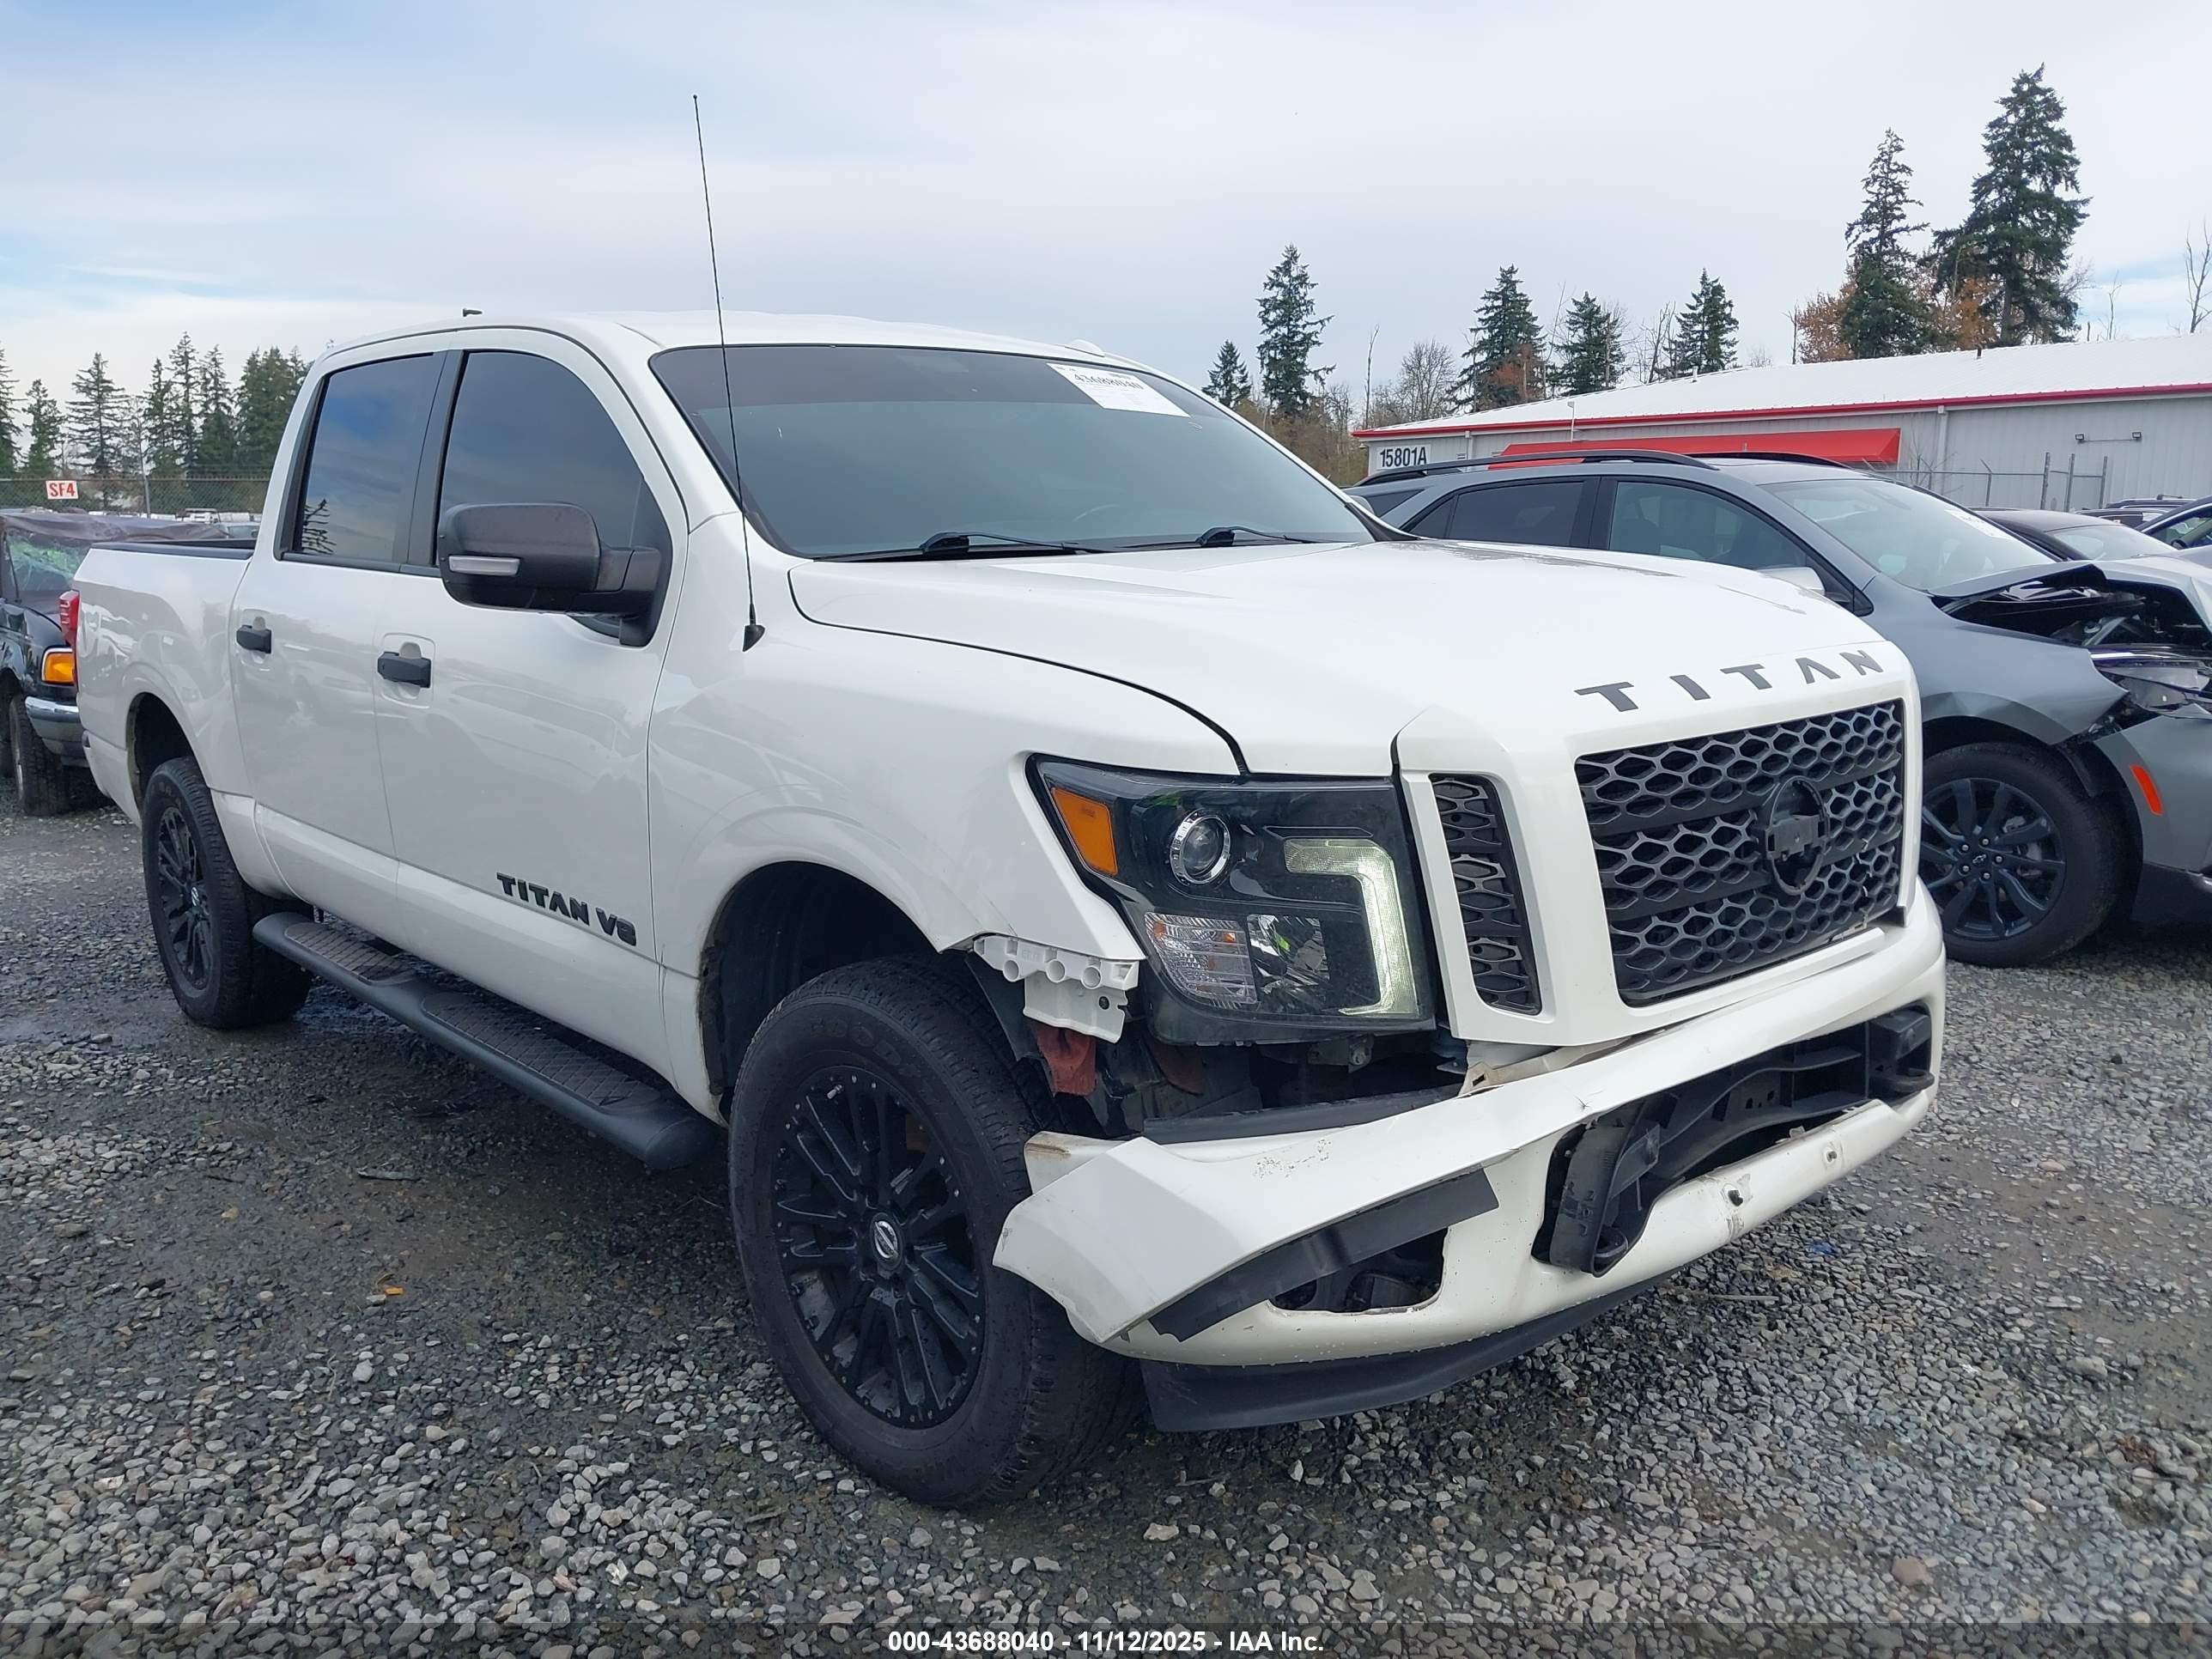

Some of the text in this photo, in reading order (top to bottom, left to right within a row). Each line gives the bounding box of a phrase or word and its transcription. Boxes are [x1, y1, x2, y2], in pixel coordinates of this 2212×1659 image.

[1379, 446, 1427, 467] 15801A
[48, 482, 76, 497] SF4
[1574, 650, 1885, 714] TITAN
[495, 872, 637, 947] TITAN V8
